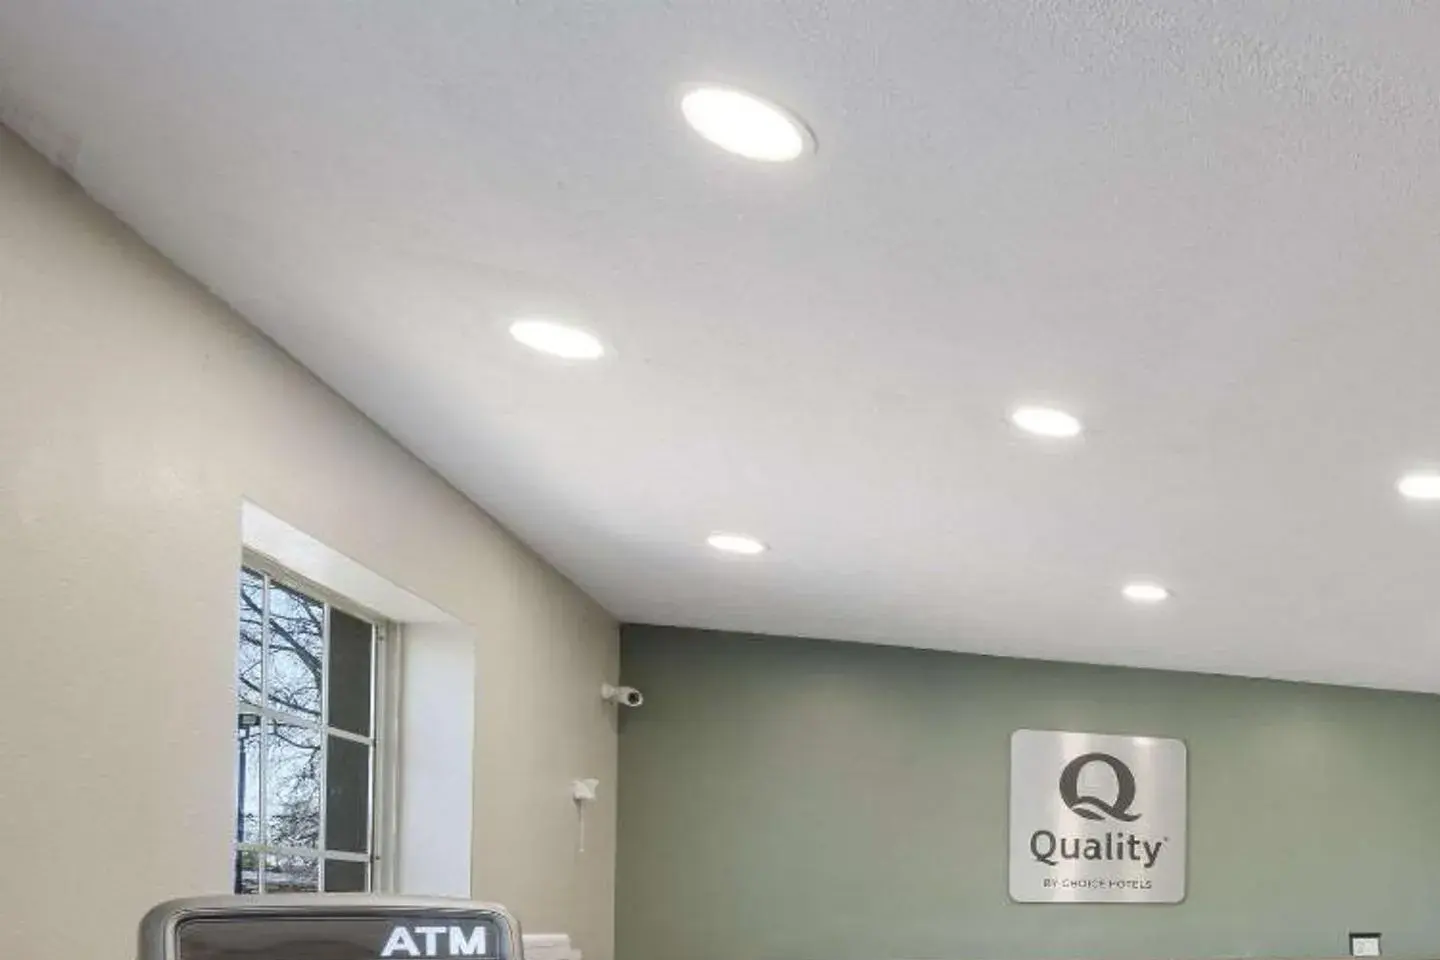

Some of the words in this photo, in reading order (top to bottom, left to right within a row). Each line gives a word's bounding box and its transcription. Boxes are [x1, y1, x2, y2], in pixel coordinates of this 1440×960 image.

[1058, 752, 1143, 822] Q
[1030, 829, 1163, 869] Quality
[1043, 878, 1058, 889] BY
[1062, 878, 1106, 890] CHOICE
[1109, 879, 1153, 890] HOTELS
[380, 925, 487, 957] ATM
